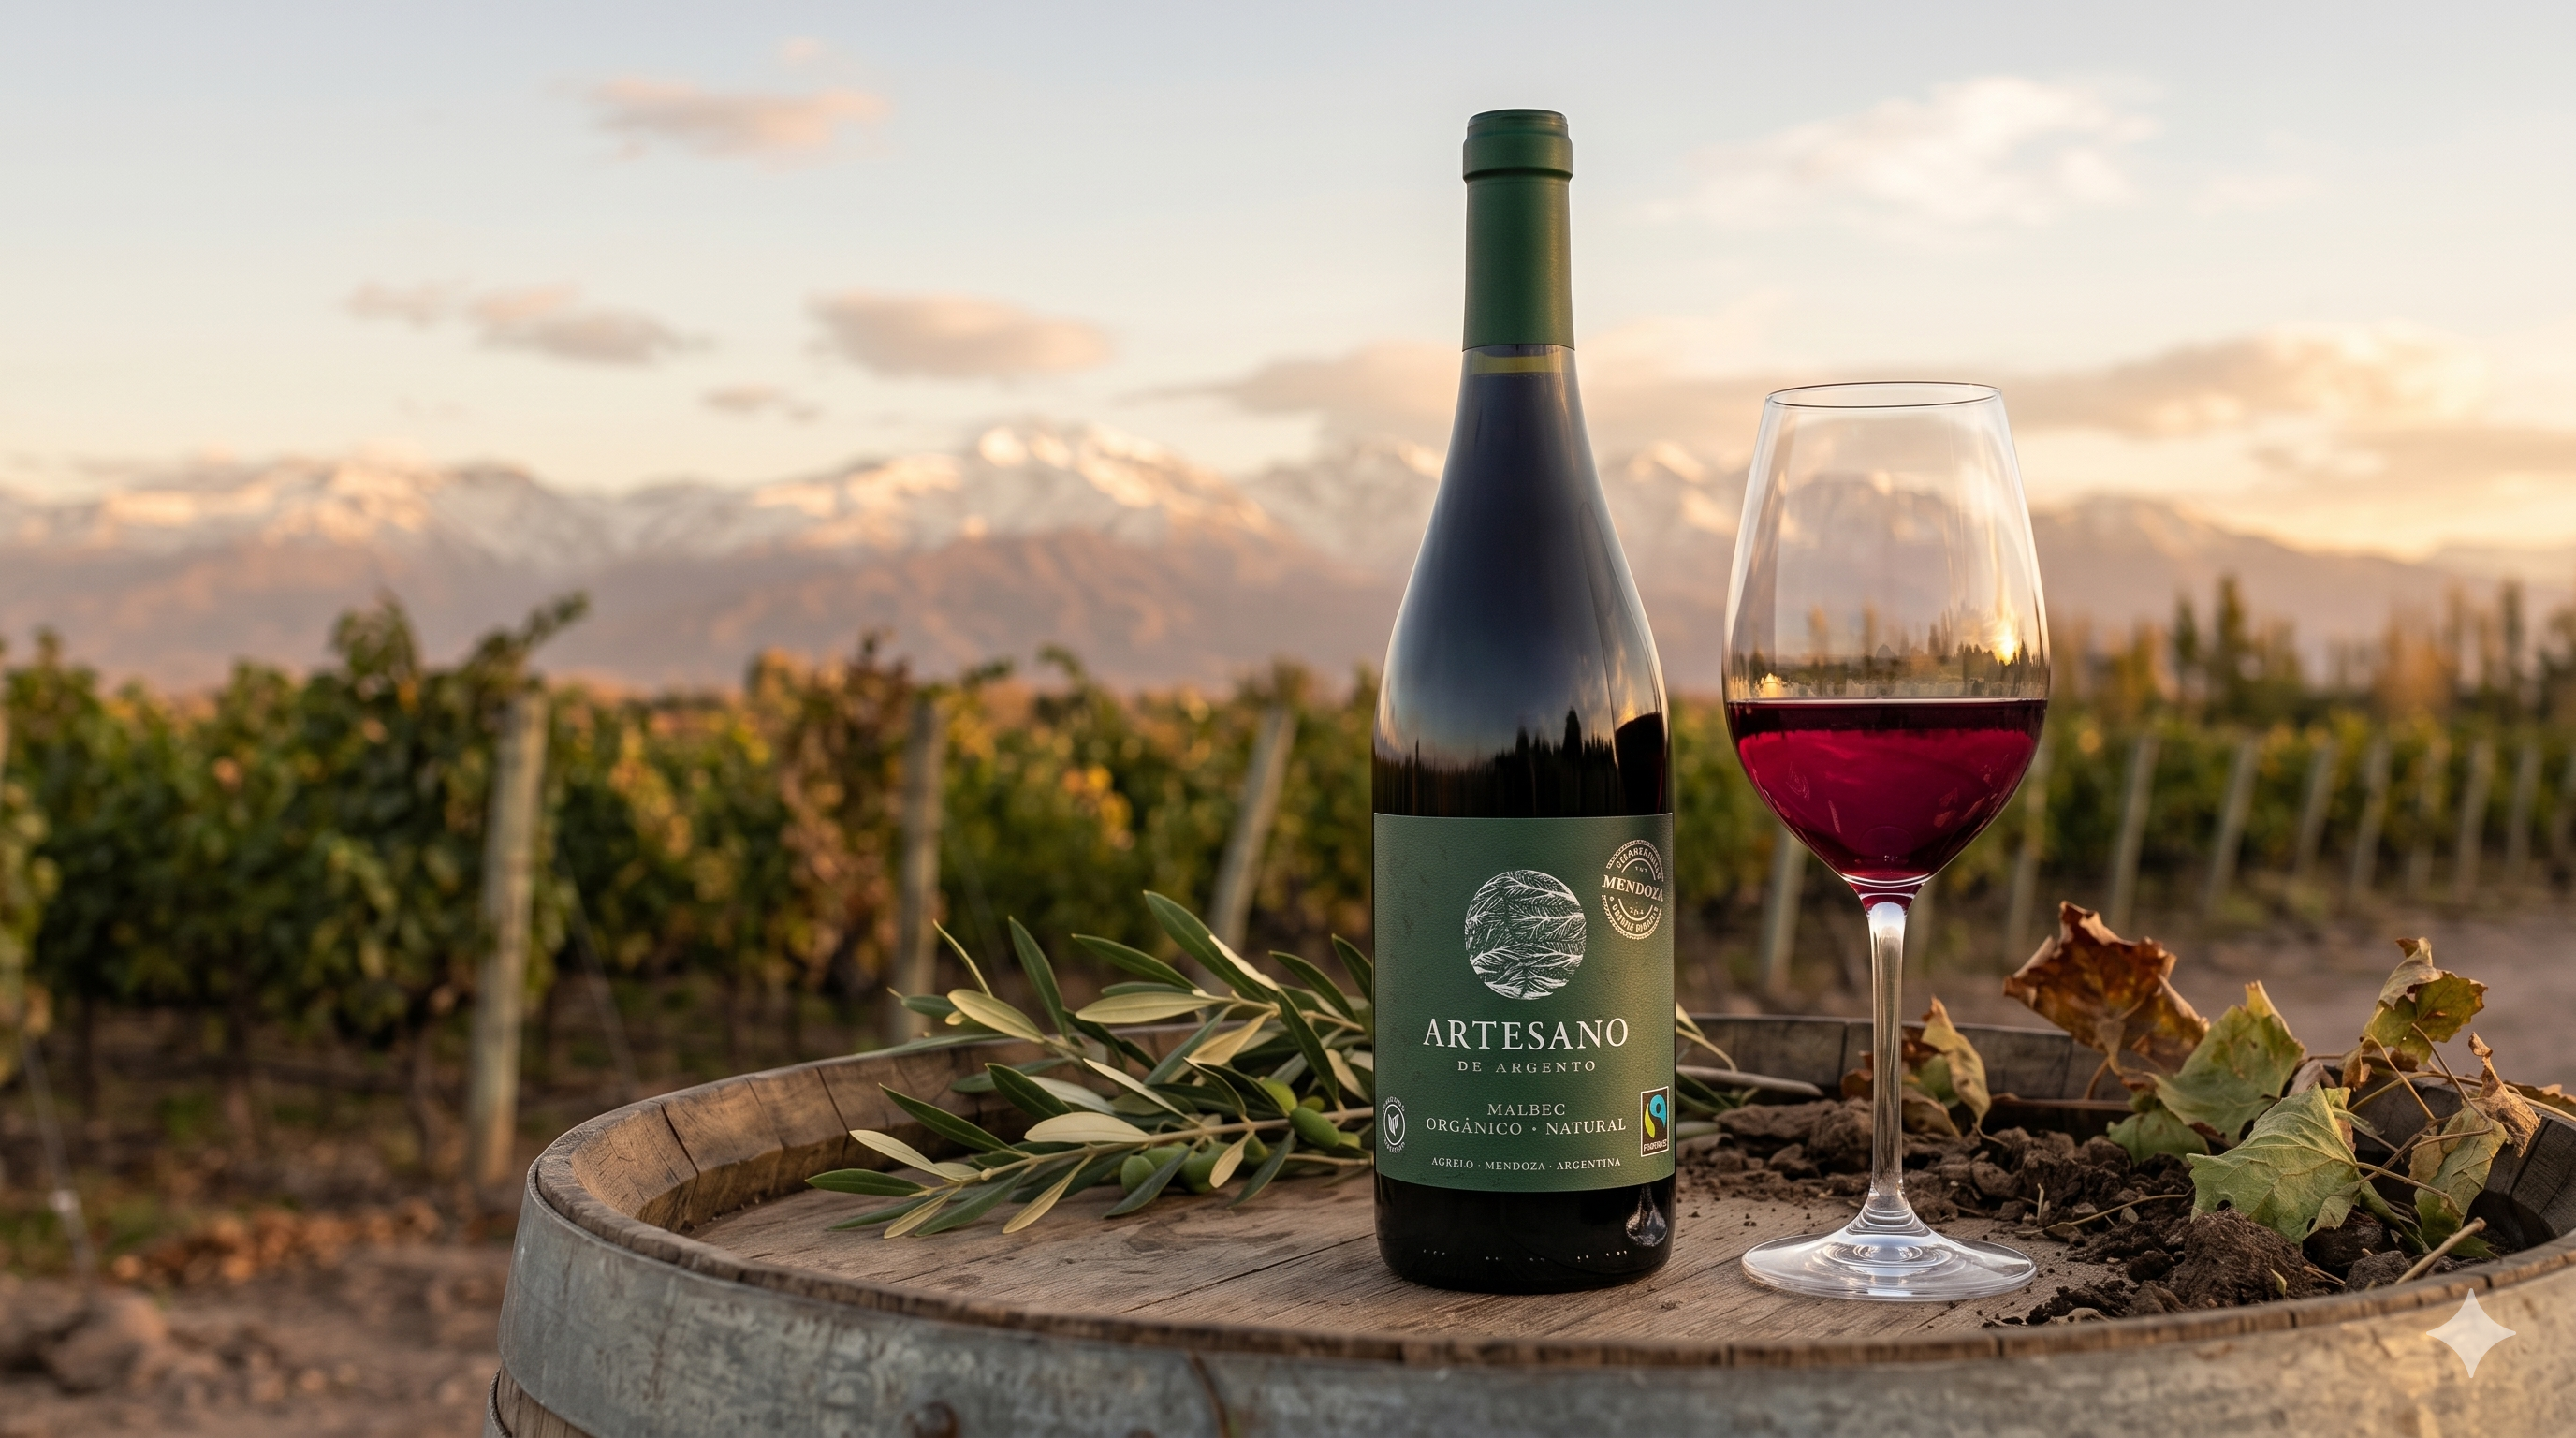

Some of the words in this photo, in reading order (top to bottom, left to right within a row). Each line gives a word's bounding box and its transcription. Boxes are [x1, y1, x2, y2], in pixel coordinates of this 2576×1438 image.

[1601, 874, 1664, 902] MENDOZA
[1423, 1018, 1629, 1050] ARTESANO
[1457, 1061, 1482, 1072] DE
[1495, 1060, 1596, 1074] ARGENTO
[1487, 1103, 1566, 1116] MALBEC
[1545, 1118, 1627, 1136] NATURAL
[1431, 1157, 1474, 1168] AGRELO
[1485, 1161, 1545, 1170] MENDOZA
[1556, 1157, 1621, 1170] ARGENTINA
